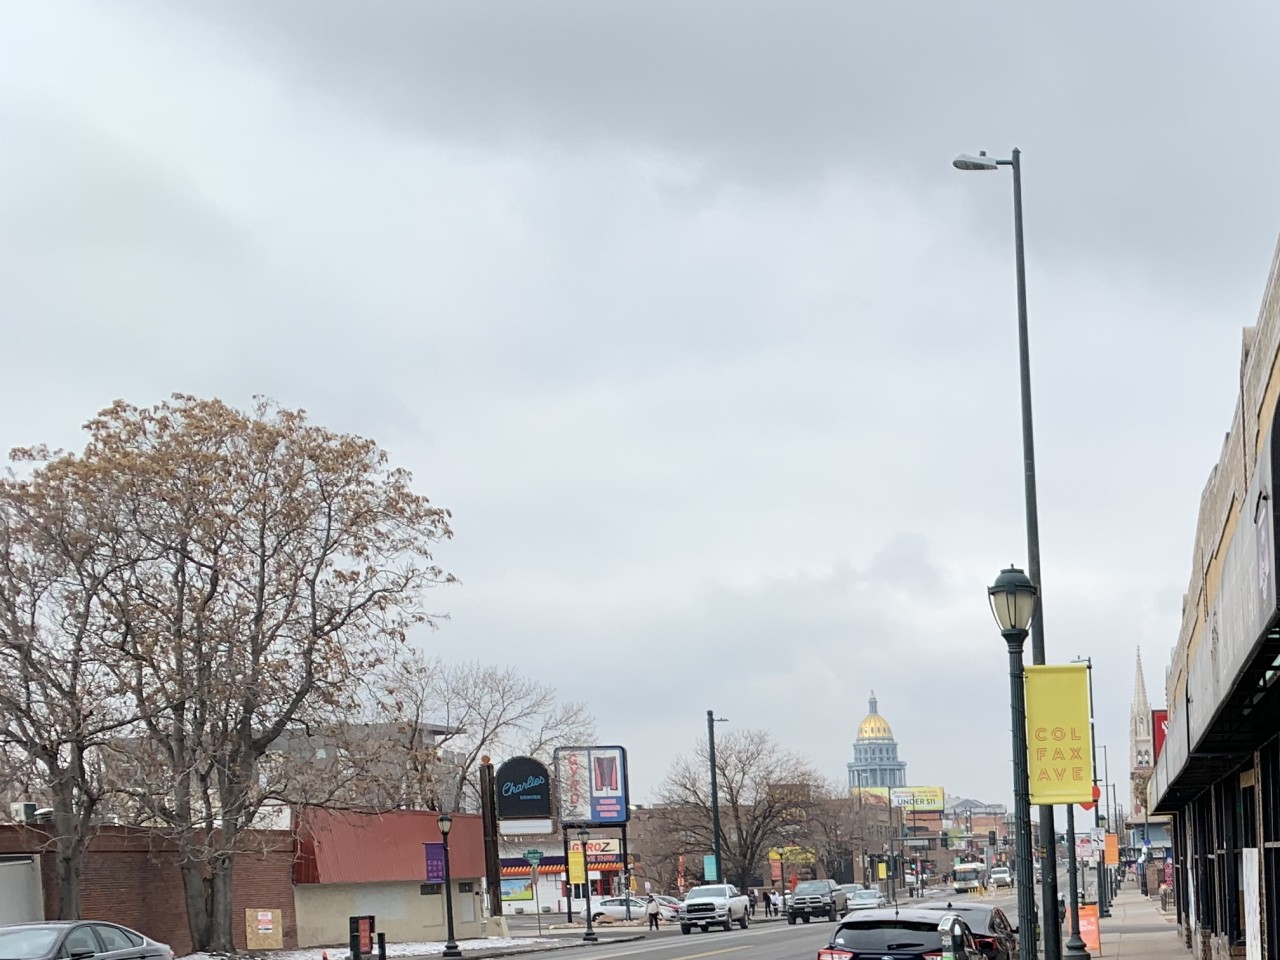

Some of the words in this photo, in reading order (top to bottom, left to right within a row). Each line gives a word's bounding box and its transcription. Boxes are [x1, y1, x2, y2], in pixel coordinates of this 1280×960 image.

[1035, 727, 1082, 741] COL
[1037, 747, 1083, 761] FAX
[1037, 767, 1083, 781] AVE
[572, 842, 616, 852] GROZ
